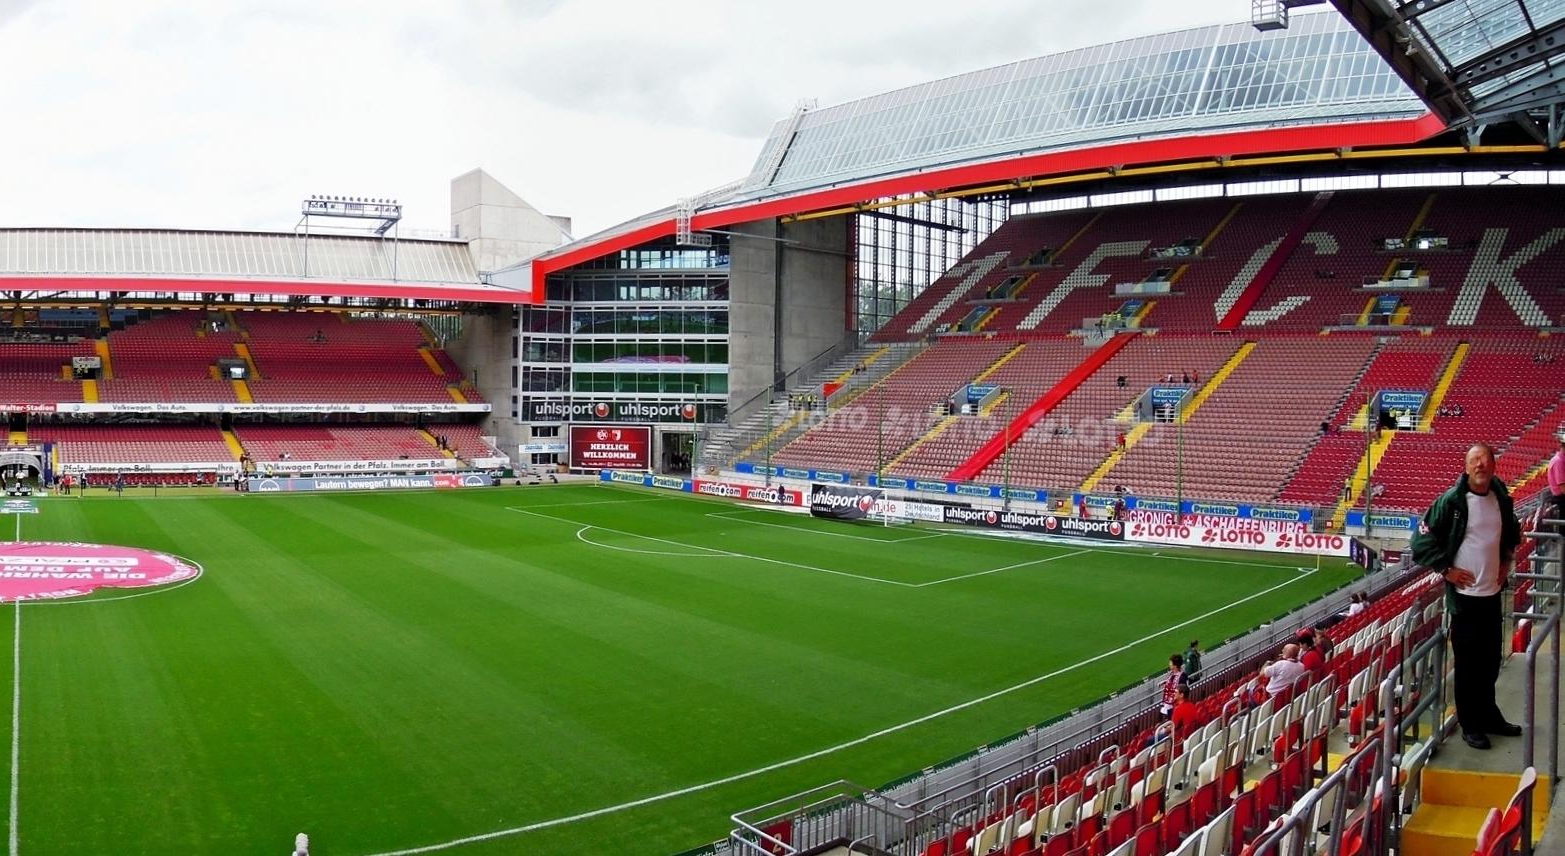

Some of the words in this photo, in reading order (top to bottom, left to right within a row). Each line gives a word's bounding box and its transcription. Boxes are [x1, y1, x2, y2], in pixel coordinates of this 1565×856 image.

[1384, 394, 1422, 402] Praktiker
[536, 402, 593, 416] uhlsport
[620, 403, 681, 417] uhlsport
[583, 451, 637, 459] WILLKOMMEN
[314, 461, 342, 471] Partner
[353, 461, 366, 469] der
[391, 461, 415, 469] Immer
[612, 472, 643, 483] Praktiker
[654, 476, 682, 488] Praktiker
[315, 479, 346, 489] Lautern
[348, 478, 389, 490] bewegen?
[390, 478, 410, 488] MAN
[916, 482, 946, 491] Praktiker
[957, 485, 989, 496] Praktiker
[812, 492, 858, 508] uhlsport
[1138, 501, 1179, 512] Praktiker
[1194, 505, 1237, 515] Praktiker
[946, 508, 986, 521] uhlsport
[1001, 513, 1045, 527] uhlsport
[1253, 509, 1298, 520] Praktiker
[1062, 520, 1108, 534] uhlsport
[1148, 525, 1191, 539] LOTTO
[1220, 529, 1266, 544] LOTTO
[1295, 534, 1344, 550] LOTTO
[102, 572, 146, 580] DIE
